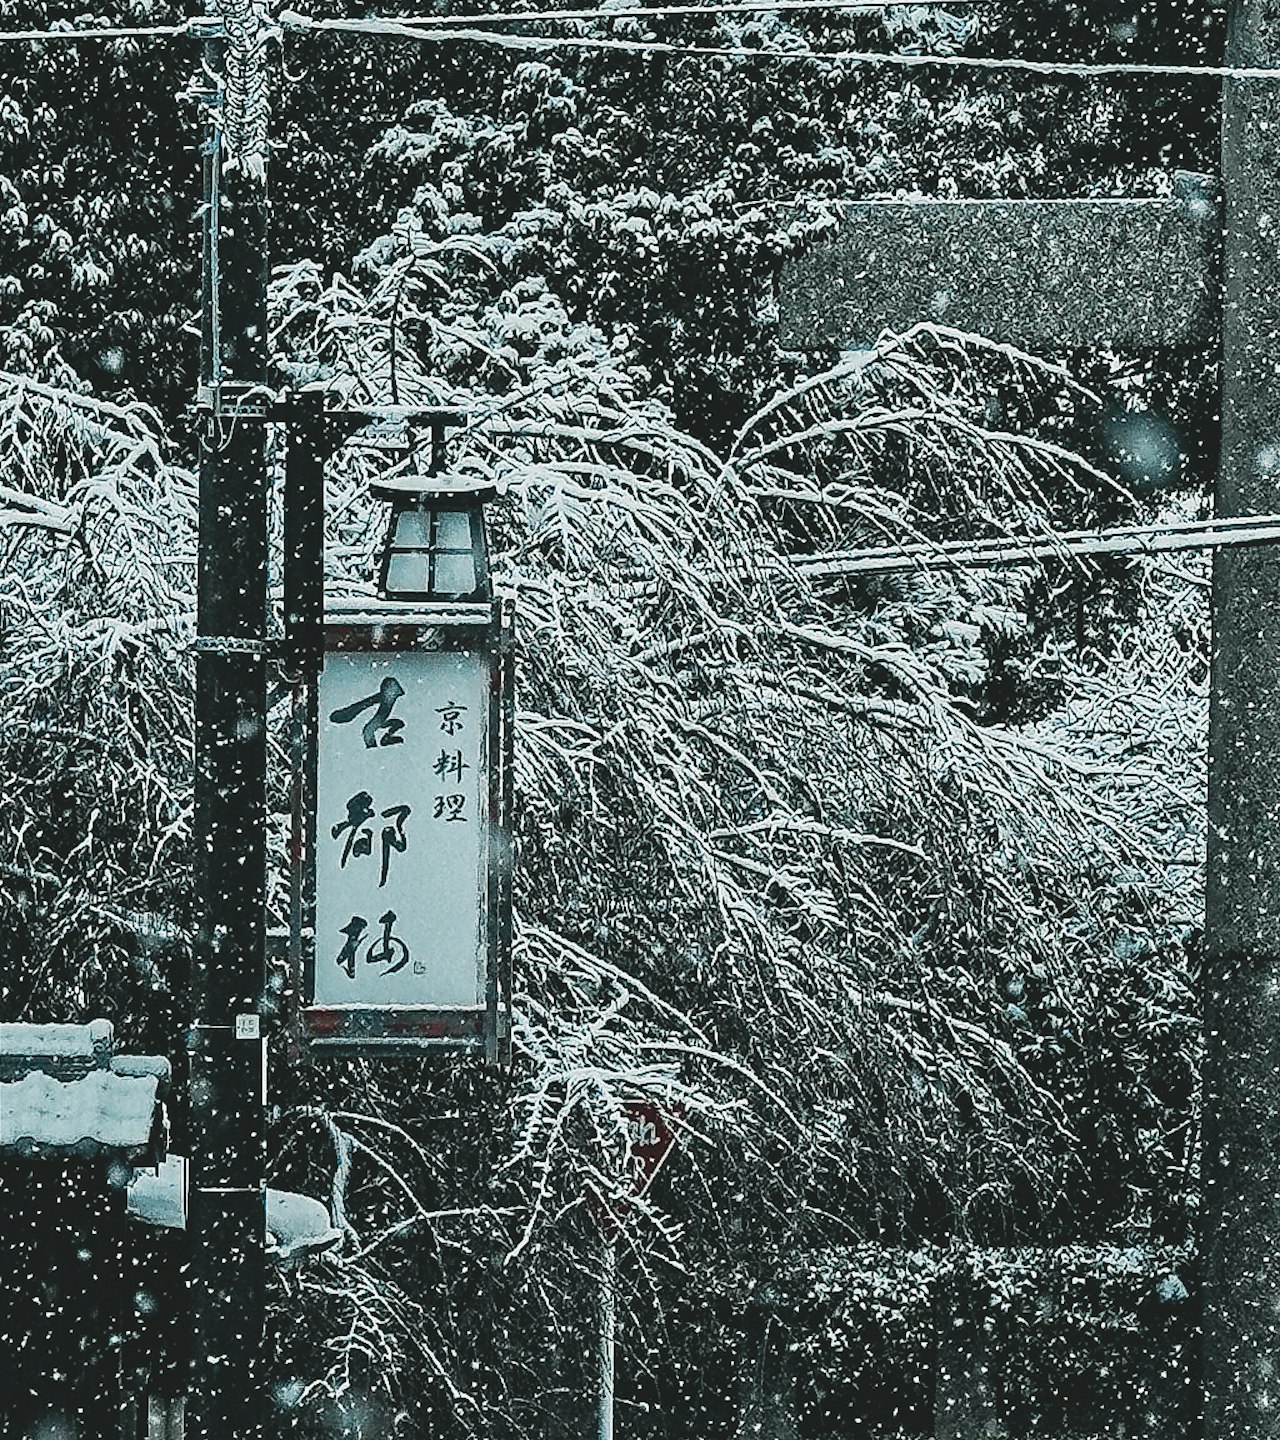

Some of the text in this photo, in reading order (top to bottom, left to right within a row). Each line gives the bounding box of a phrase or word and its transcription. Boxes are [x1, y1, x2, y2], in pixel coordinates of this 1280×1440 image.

[329, 676, 411, 980] 古都梅
[432, 700, 470, 823] 京料理
